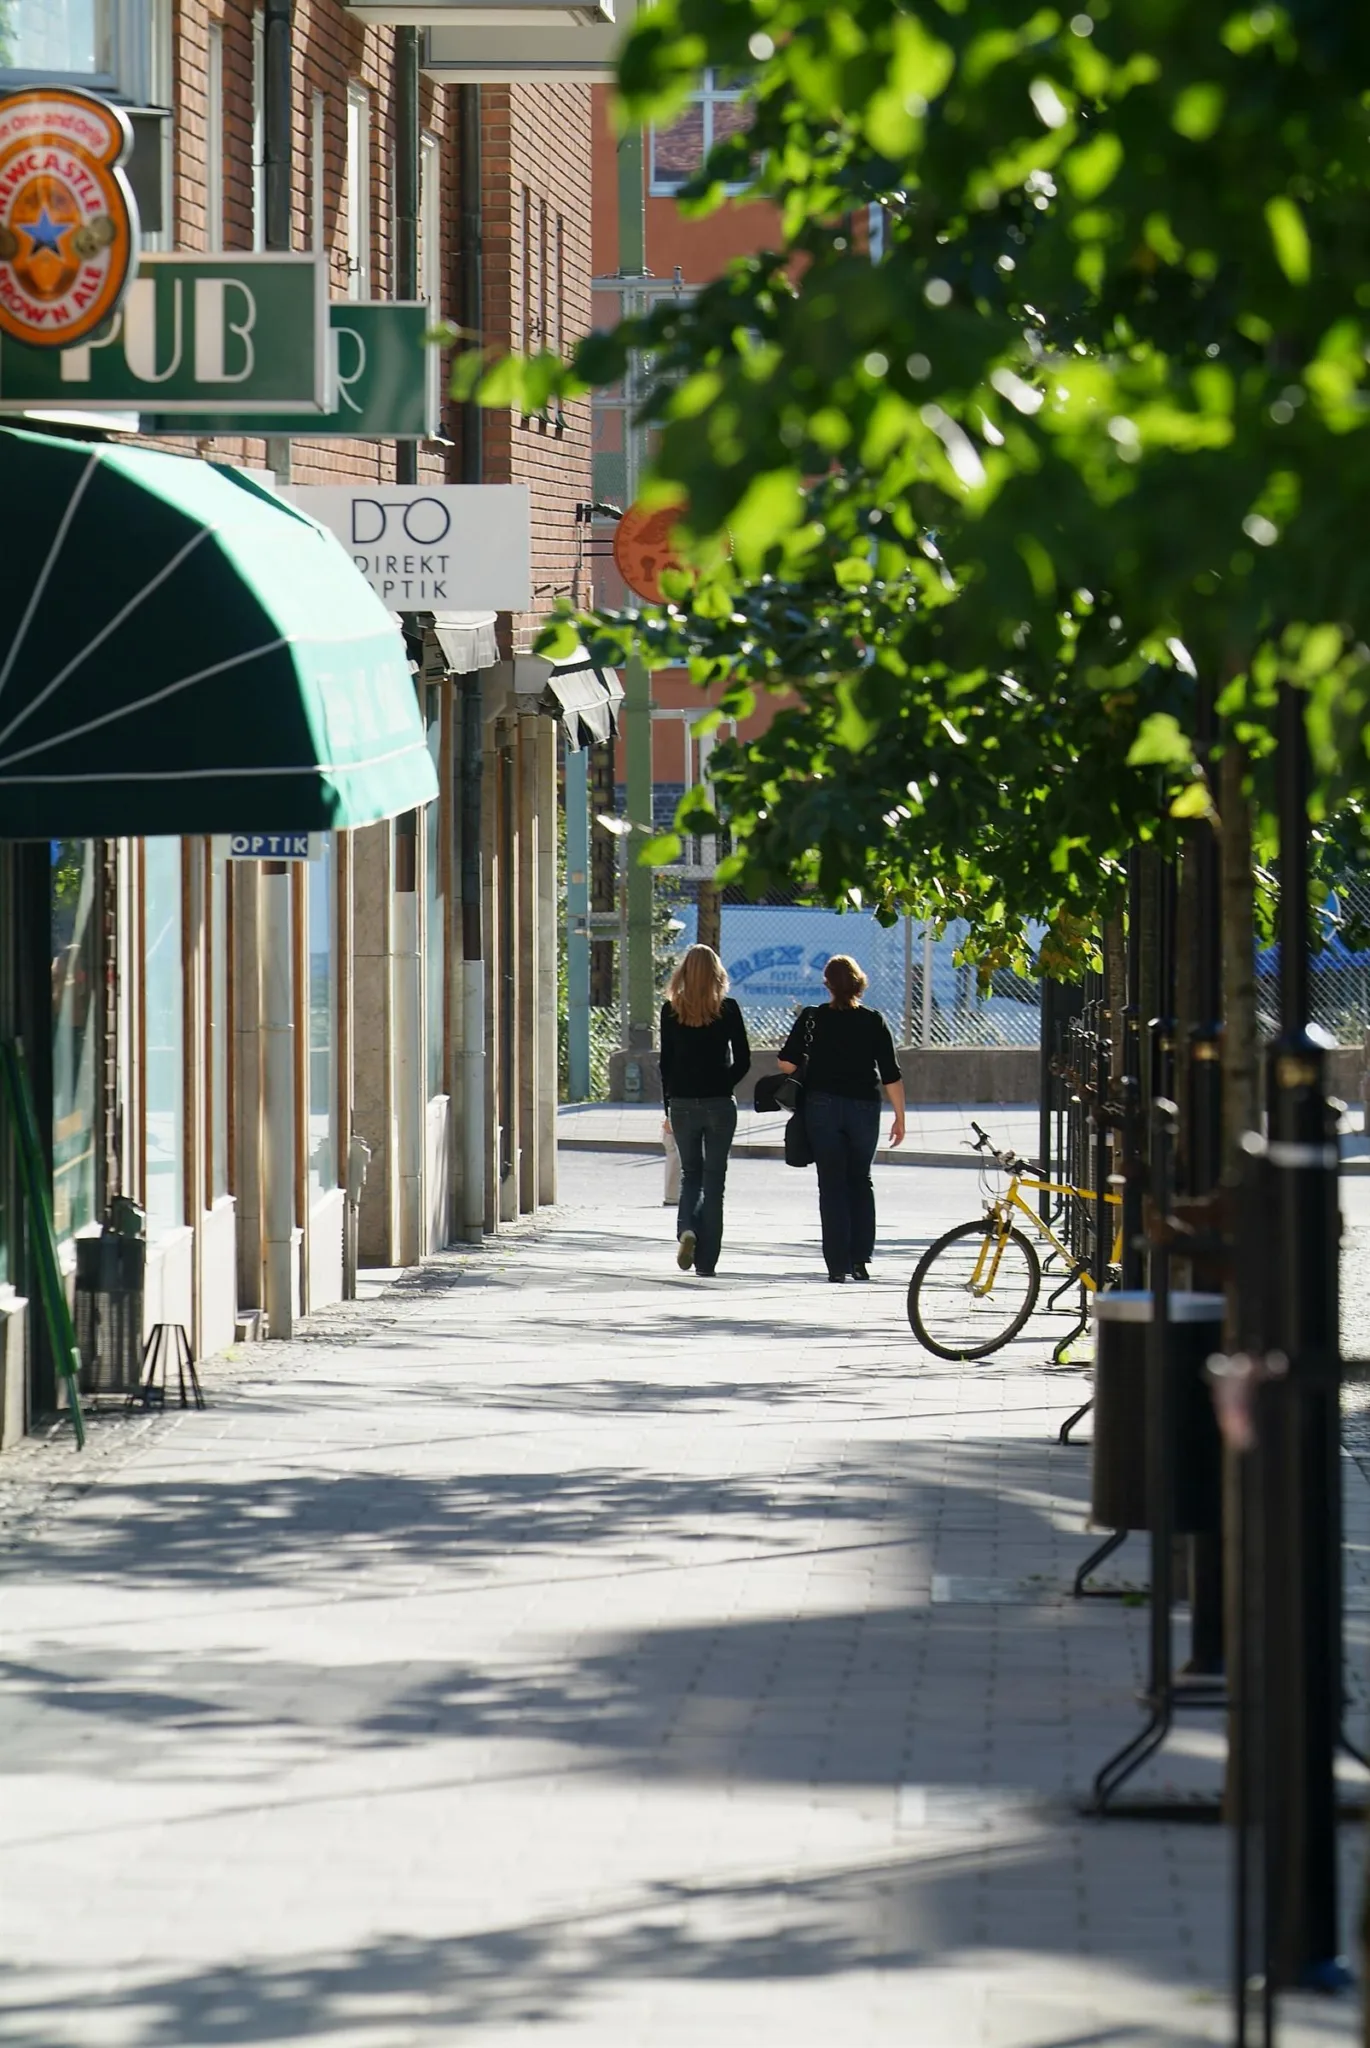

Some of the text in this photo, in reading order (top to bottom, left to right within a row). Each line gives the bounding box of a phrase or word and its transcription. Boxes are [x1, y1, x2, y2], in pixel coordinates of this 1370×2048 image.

[73, 267, 102, 309] ALE
[353, 555, 450, 574] DIREKT
[368, 580, 447, 599] PTIK
[231, 836, 307, 854] OPTIK
